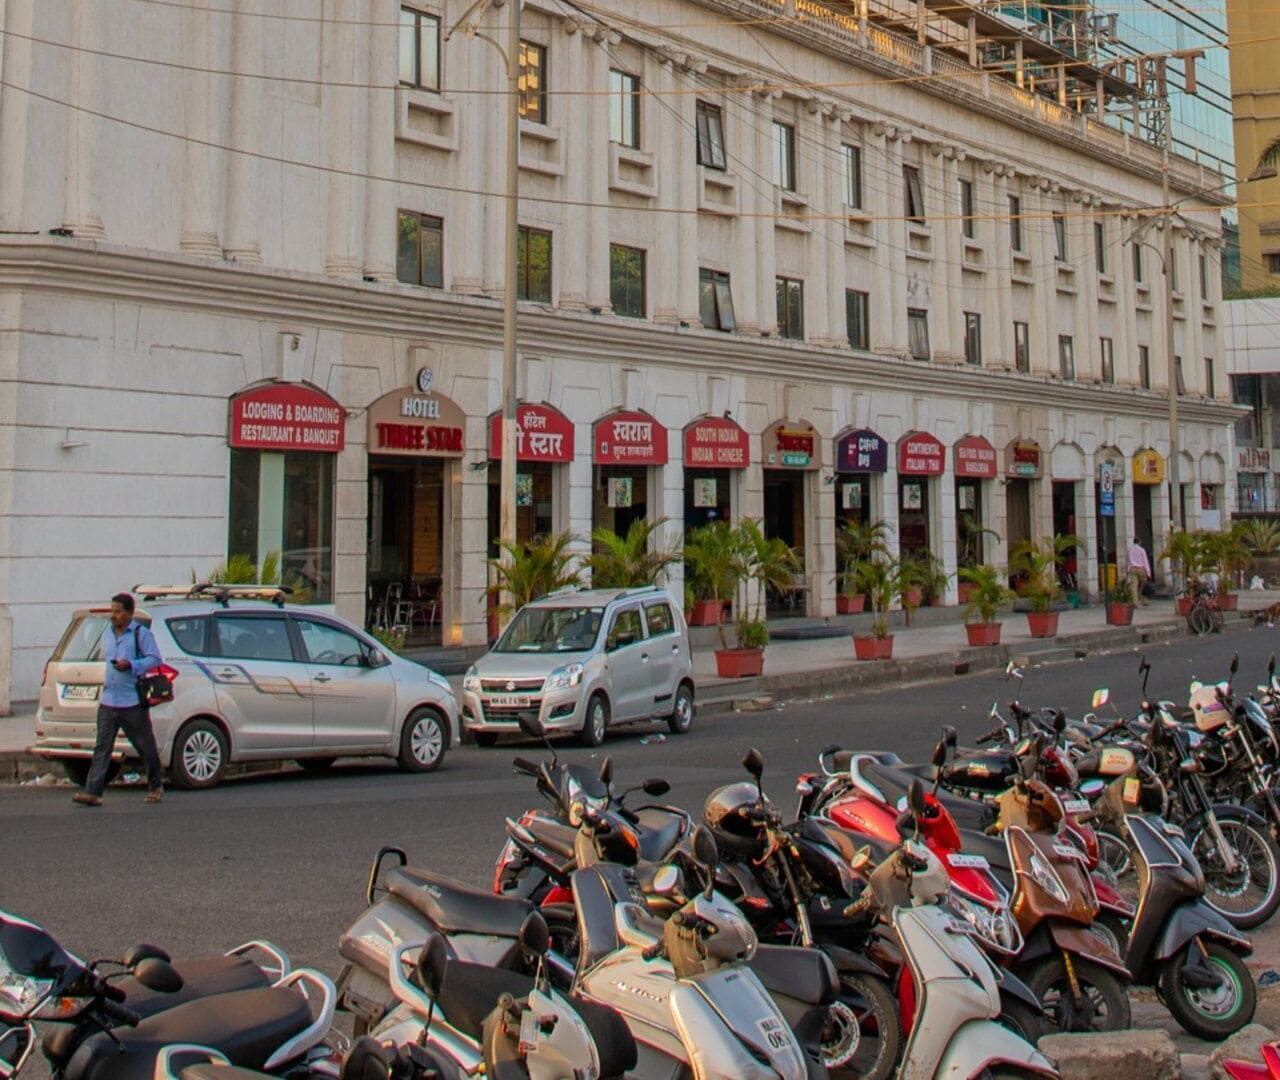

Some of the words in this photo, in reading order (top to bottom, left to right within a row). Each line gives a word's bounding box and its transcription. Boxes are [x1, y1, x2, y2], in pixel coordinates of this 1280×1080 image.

[242, 401, 284, 420] LODGING
[285, 404, 293, 421] &
[294, 405, 340, 424] BOARDING
[401, 397, 440, 419] HOTEL
[523, 411, 547, 430] हॉटेल
[241, 423, 294, 442] RESTAURANT
[295, 426, 302, 443] &
[303, 427, 340, 446] BANQUET
[377, 422, 425, 449] THREE
[426, 425, 463, 452] STAR
[613, 421, 653, 443] स्वराज
[695, 427, 716, 443] SOUTH
[718, 427, 739, 443] INDIAN
[529, 432, 563, 456] स्टार
[691, 446, 713, 462] INDIAN
[717, 447, 744, 463] CHINESE
[858, 438, 879, 452] Coffee
[858, 454, 870, 467] Day
